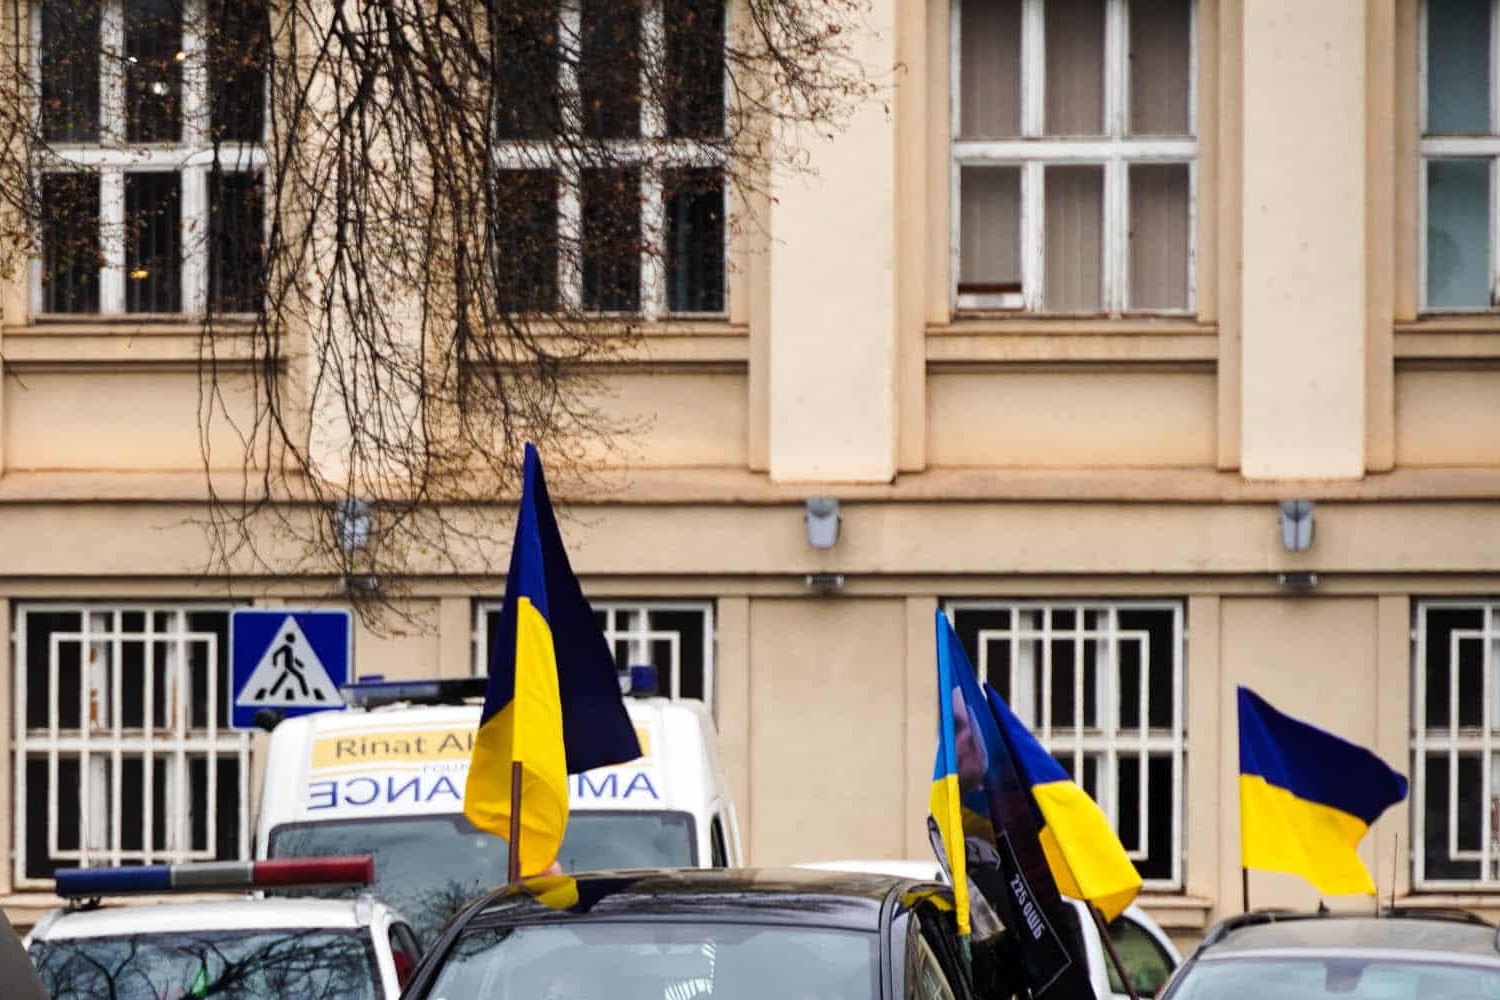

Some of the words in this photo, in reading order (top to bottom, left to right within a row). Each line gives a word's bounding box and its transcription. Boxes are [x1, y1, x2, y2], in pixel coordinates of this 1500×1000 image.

[336, 736, 424, 758] Rinat
[1010, 873, 1028, 905] 225
[1023, 901, 1045, 939] ОШБ
